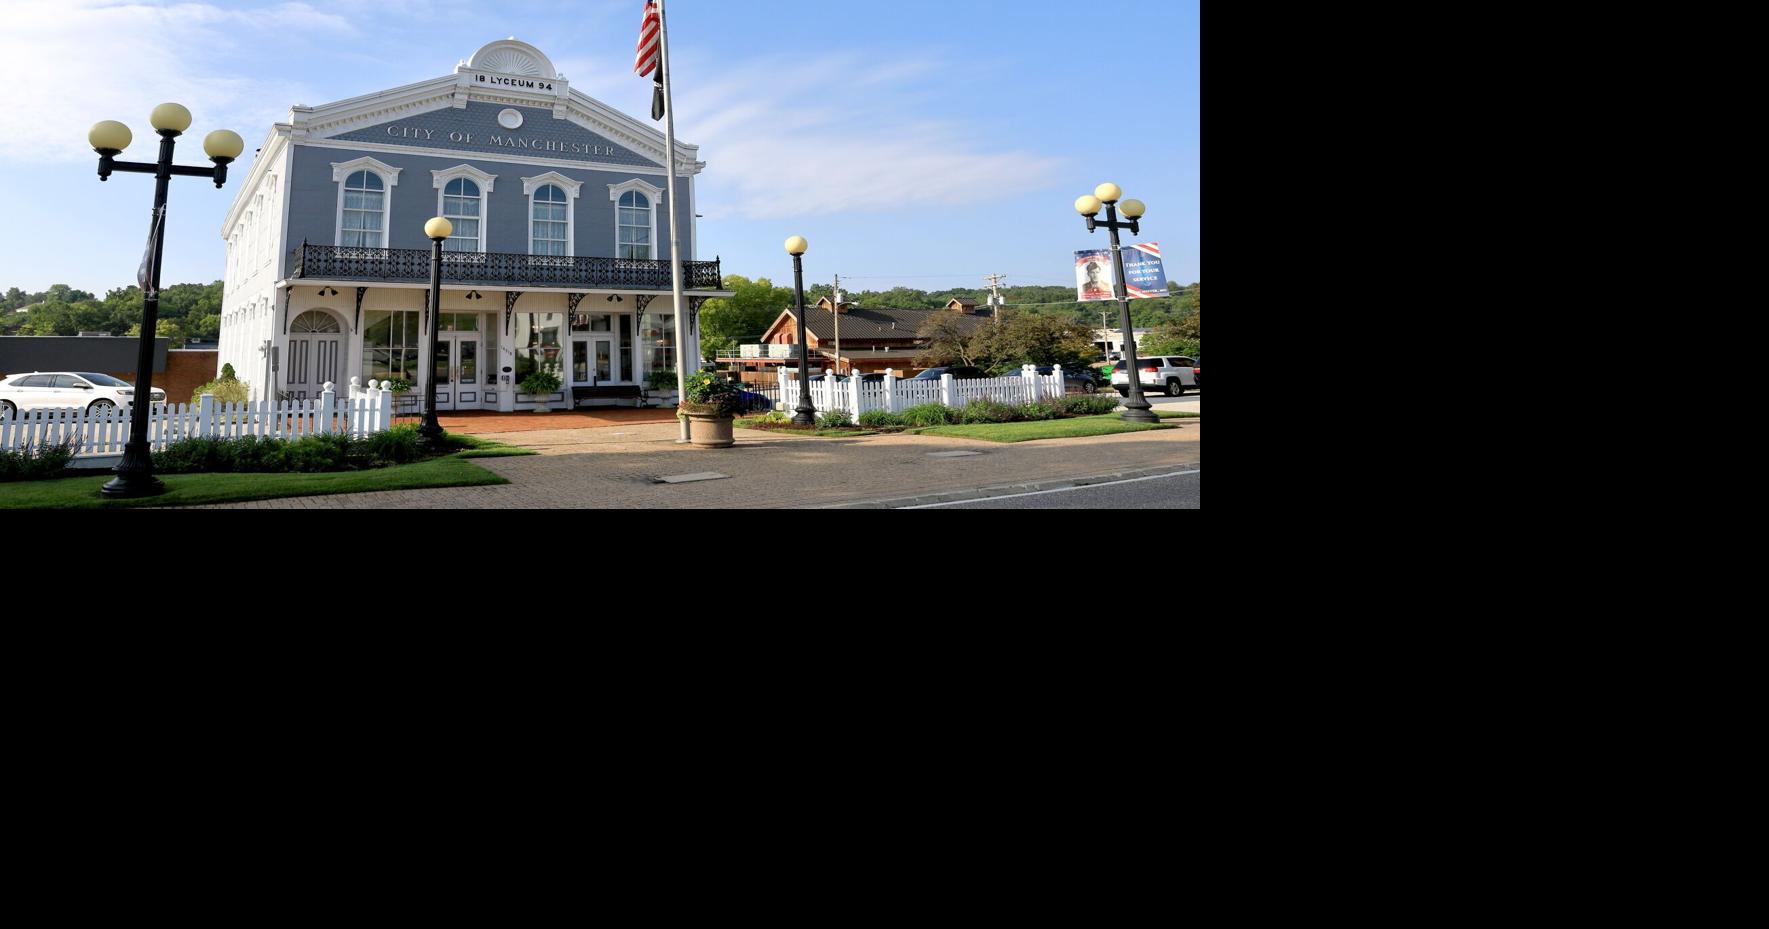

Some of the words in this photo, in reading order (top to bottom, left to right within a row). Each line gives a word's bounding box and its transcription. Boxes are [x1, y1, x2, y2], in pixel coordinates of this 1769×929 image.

[475, 74, 485, 82] 18
[490, 76, 534, 88] LYCEUM
[538, 82, 552, 91] 94
[387, 126, 434, 140] CITY
[449, 131, 474, 144] OF
[488, 135, 615, 156] MANCHESTER
